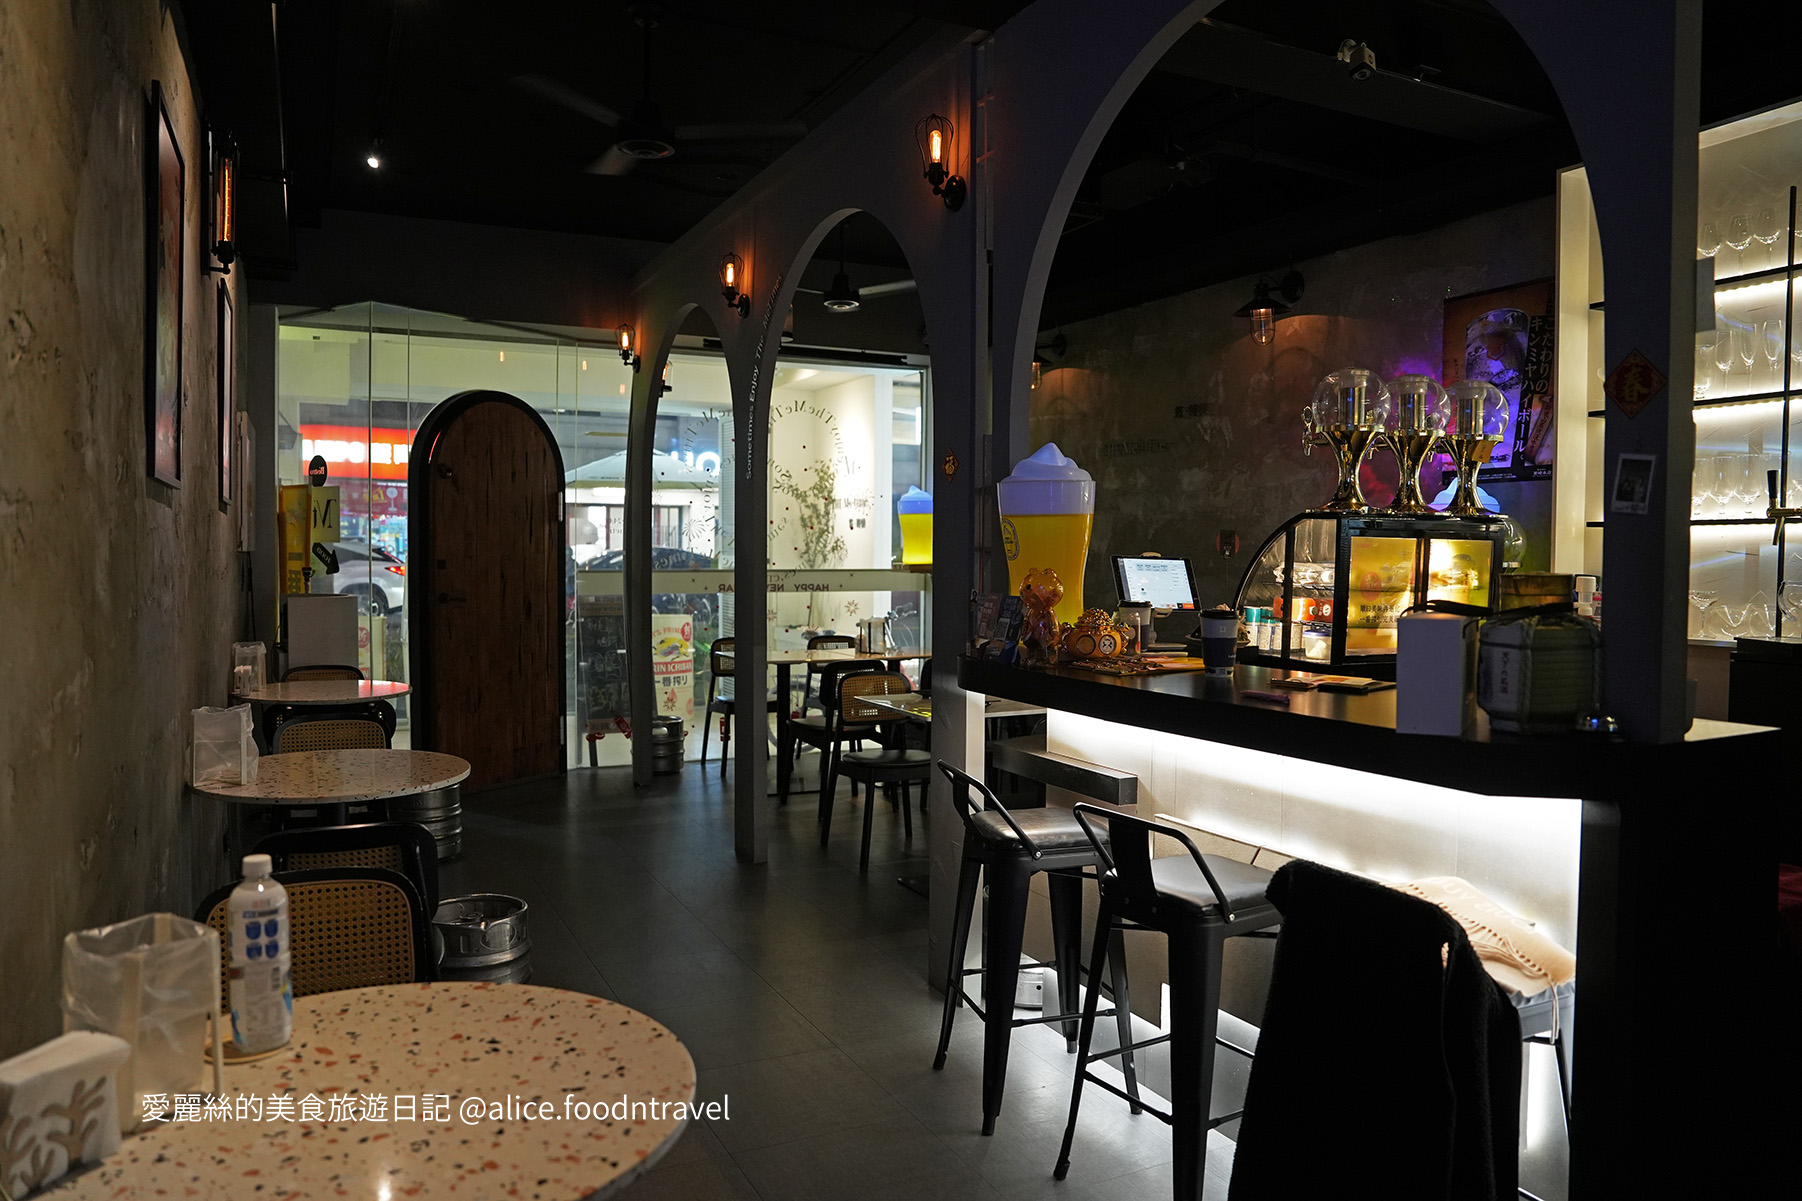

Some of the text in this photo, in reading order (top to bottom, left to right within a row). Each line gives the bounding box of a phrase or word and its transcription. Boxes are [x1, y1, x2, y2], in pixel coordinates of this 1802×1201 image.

[755, 335, 765, 359] The
[749, 365, 759, 402] Enjoy
[1621, 365, 1649, 404] 春
[746, 405, 755, 480] Sometimes
[654, 675, 688, 687] 一番搾り
[668, 661, 692, 673] ICHIBAN
